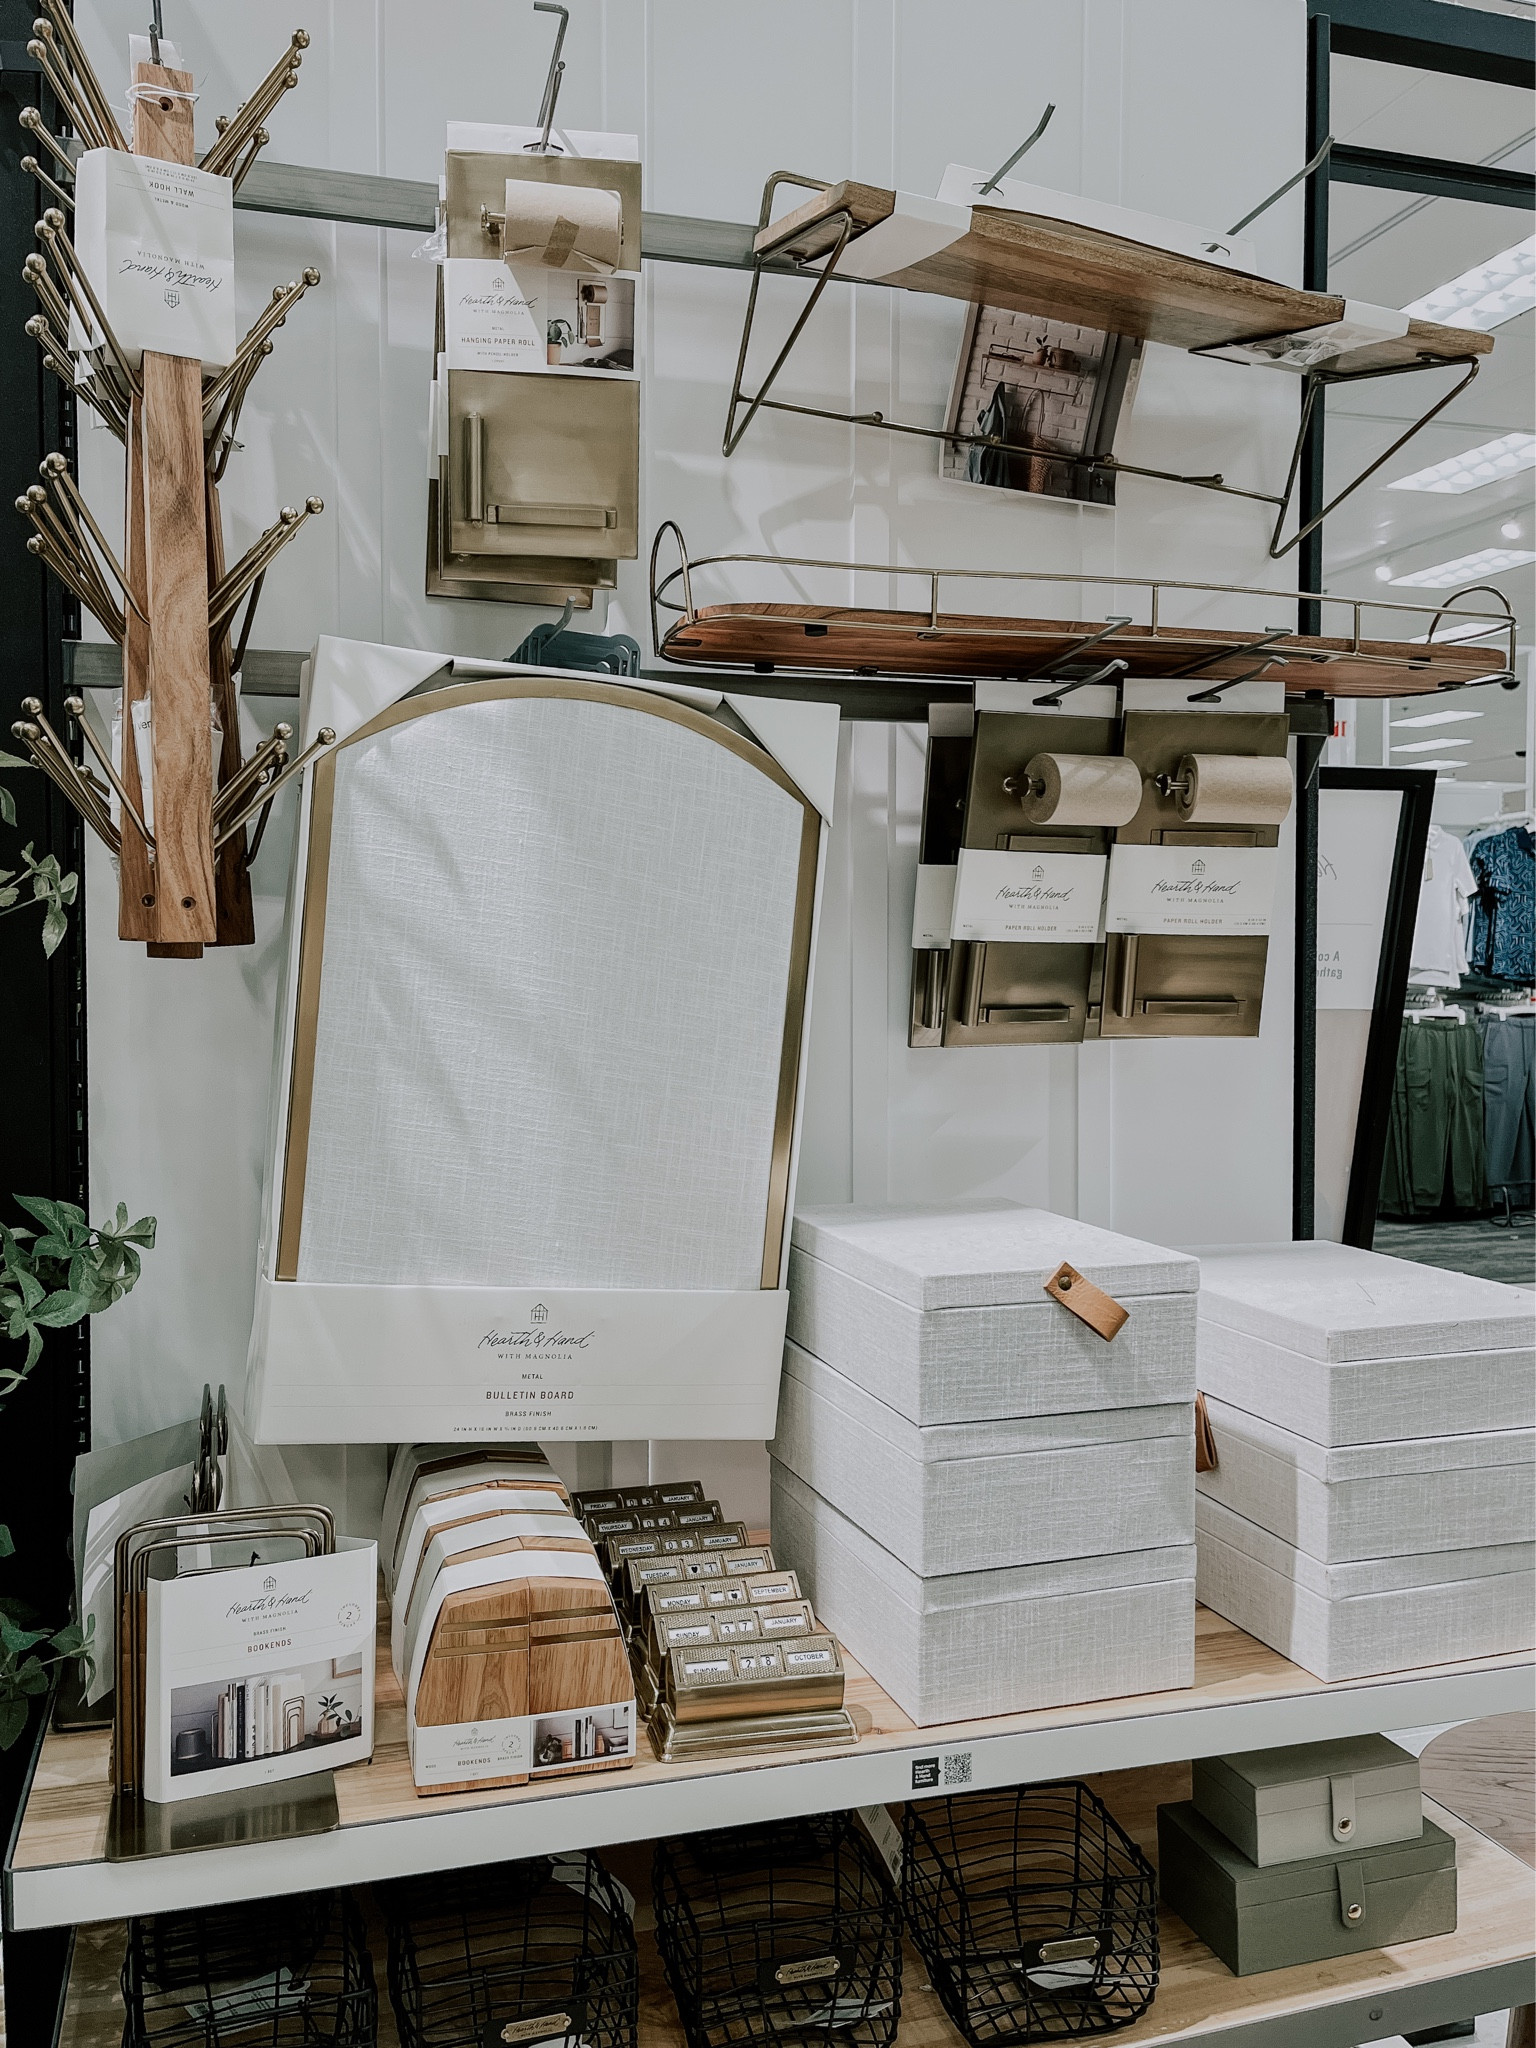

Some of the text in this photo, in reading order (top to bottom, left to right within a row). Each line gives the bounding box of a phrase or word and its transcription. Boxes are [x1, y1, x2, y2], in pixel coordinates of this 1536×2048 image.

[149, 181, 194, 198] WALL HOOK
[137, 250, 205, 270] WITH MAGNOLIA
[119, 259, 222, 292] Hearth & Hand
[459, 294, 496, 306] Hearth
[502, 296, 538, 309] Hand
[996, 885, 1074, 901] Hearth & Hand
[1151, 878, 1241, 895] Hearth & Hand
[478, 1328, 594, 1348] Hearth & Hand
[486, 1391, 574, 1399] BULLETIN BOARD
[621, 1546, 653, 1554] WEDNESDAY
[753, 1587, 787, 1595] SEPTEMBER
[226, 1595, 268, 1618] Hearth
[275, 1589, 312, 1608] Hand
[263, 1610, 298, 1619] MAGNOLIA
[743, 1622, 748, 1632] 7
[248, 1639, 292, 1653] BOOKENDS
[745, 1660, 751, 1668] 2
[766, 1656, 771, 1665] 8
[458, 1758, 491, 1766] BOOKENDS
